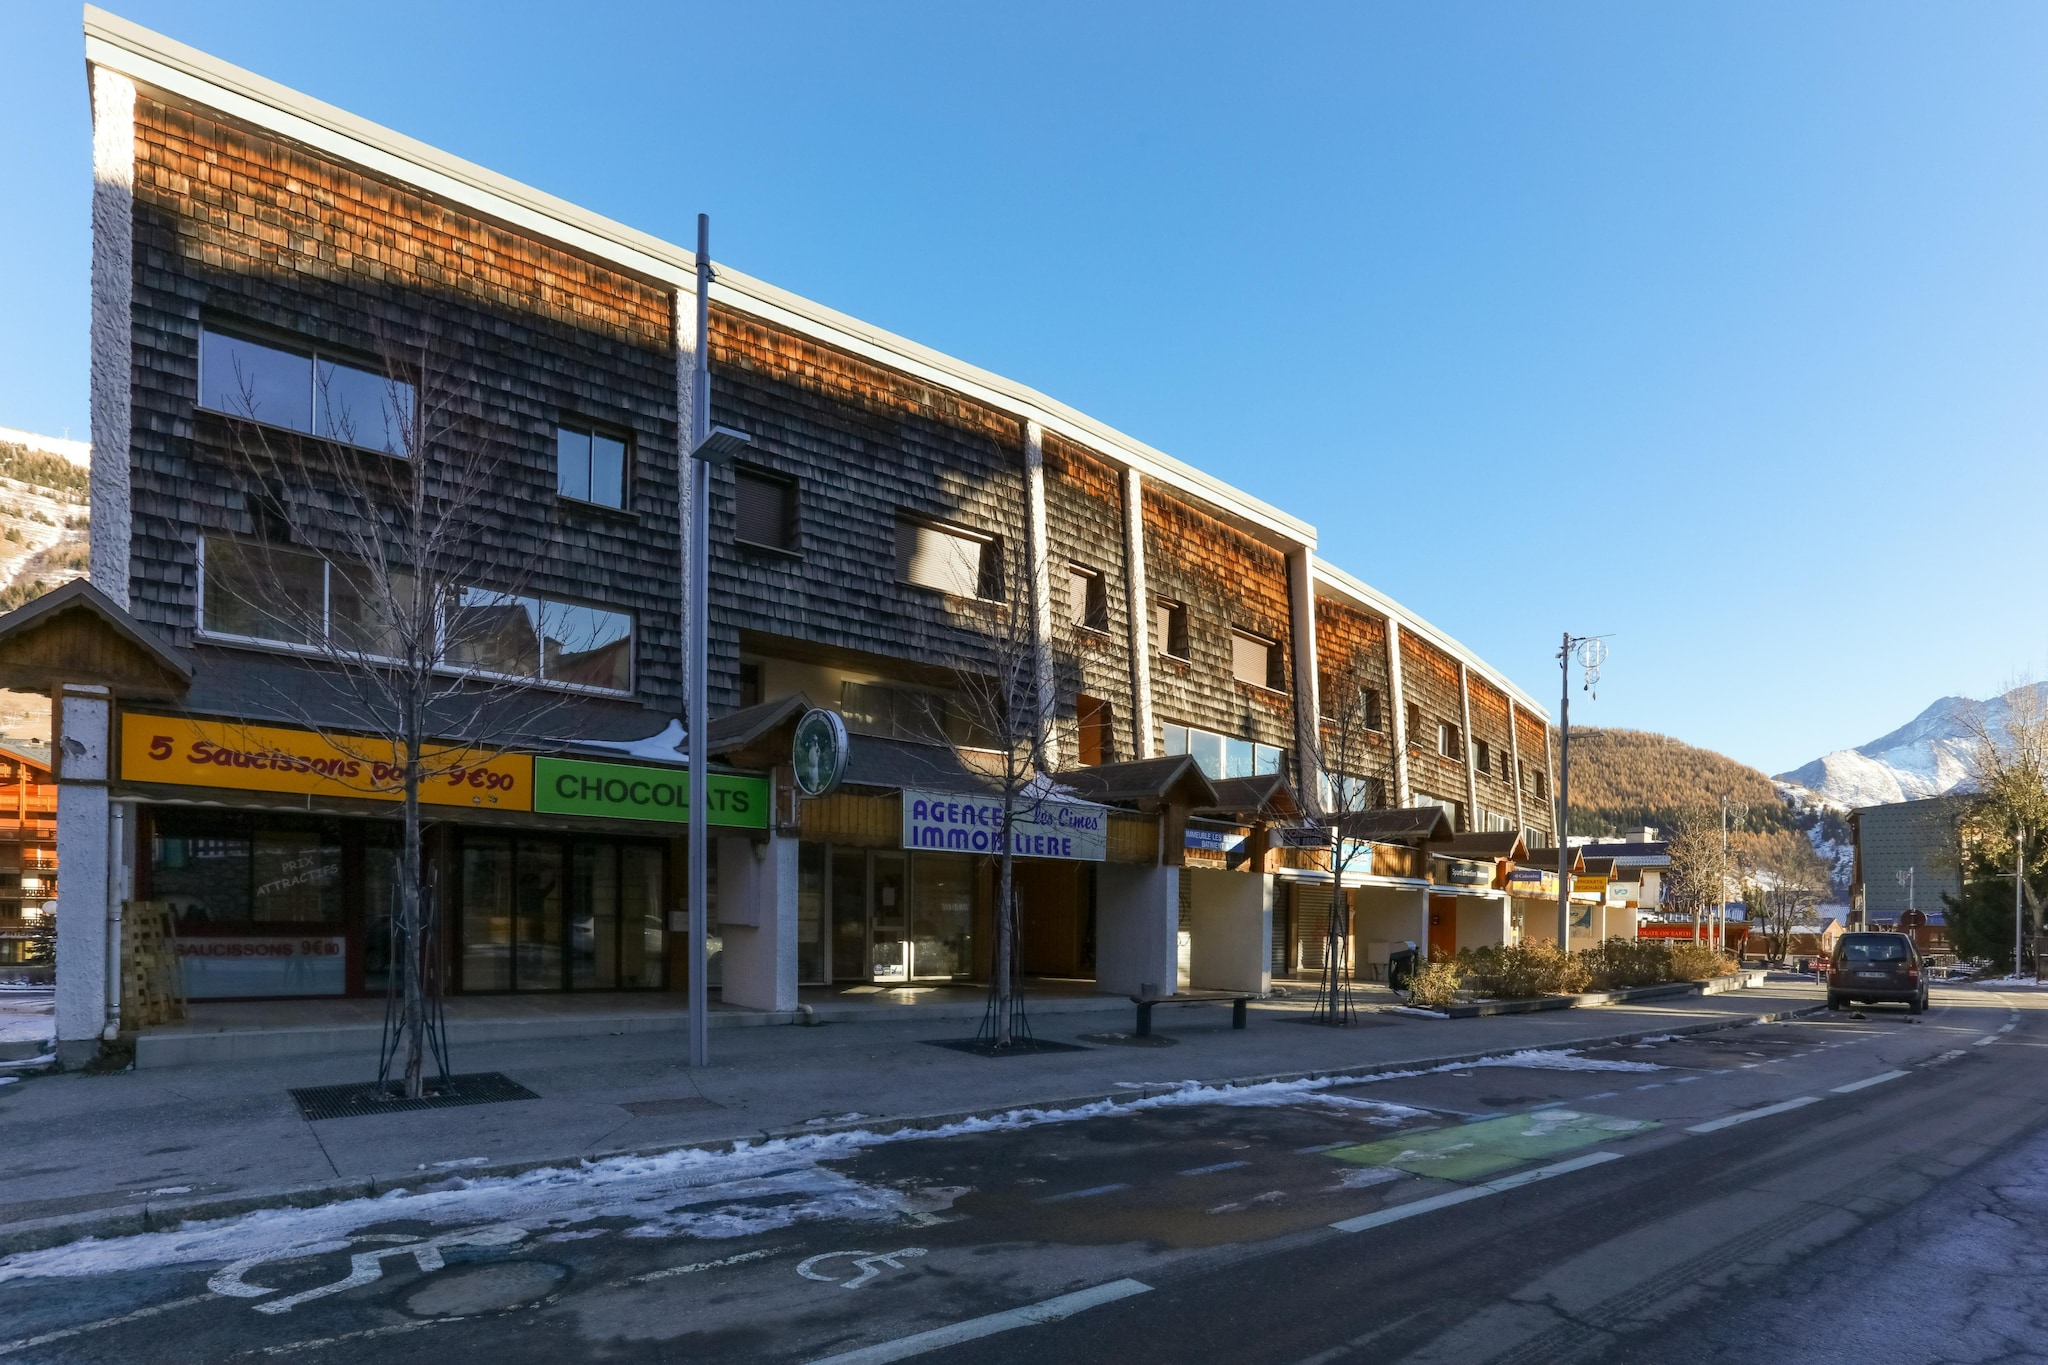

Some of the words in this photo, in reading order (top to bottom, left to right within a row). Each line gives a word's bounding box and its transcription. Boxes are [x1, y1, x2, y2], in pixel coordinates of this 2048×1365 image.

[148, 735, 174, 761] 5
[186, 741, 360, 778] Saucissons
[371, 761, 430, 787] por
[447, 764, 514, 791] 9€90
[913, 799, 1003, 827] AGENCE
[913, 825, 1071, 856] IMMOBLIERE
[1185, 830, 1211, 841] IMMEUBLE
[1212, 832, 1222, 842] LES
[281, 855, 314, 872] PRIX
[256, 864, 338, 897] ATTRACTIFS
[175, 943, 294, 957] SAUCISSONS
